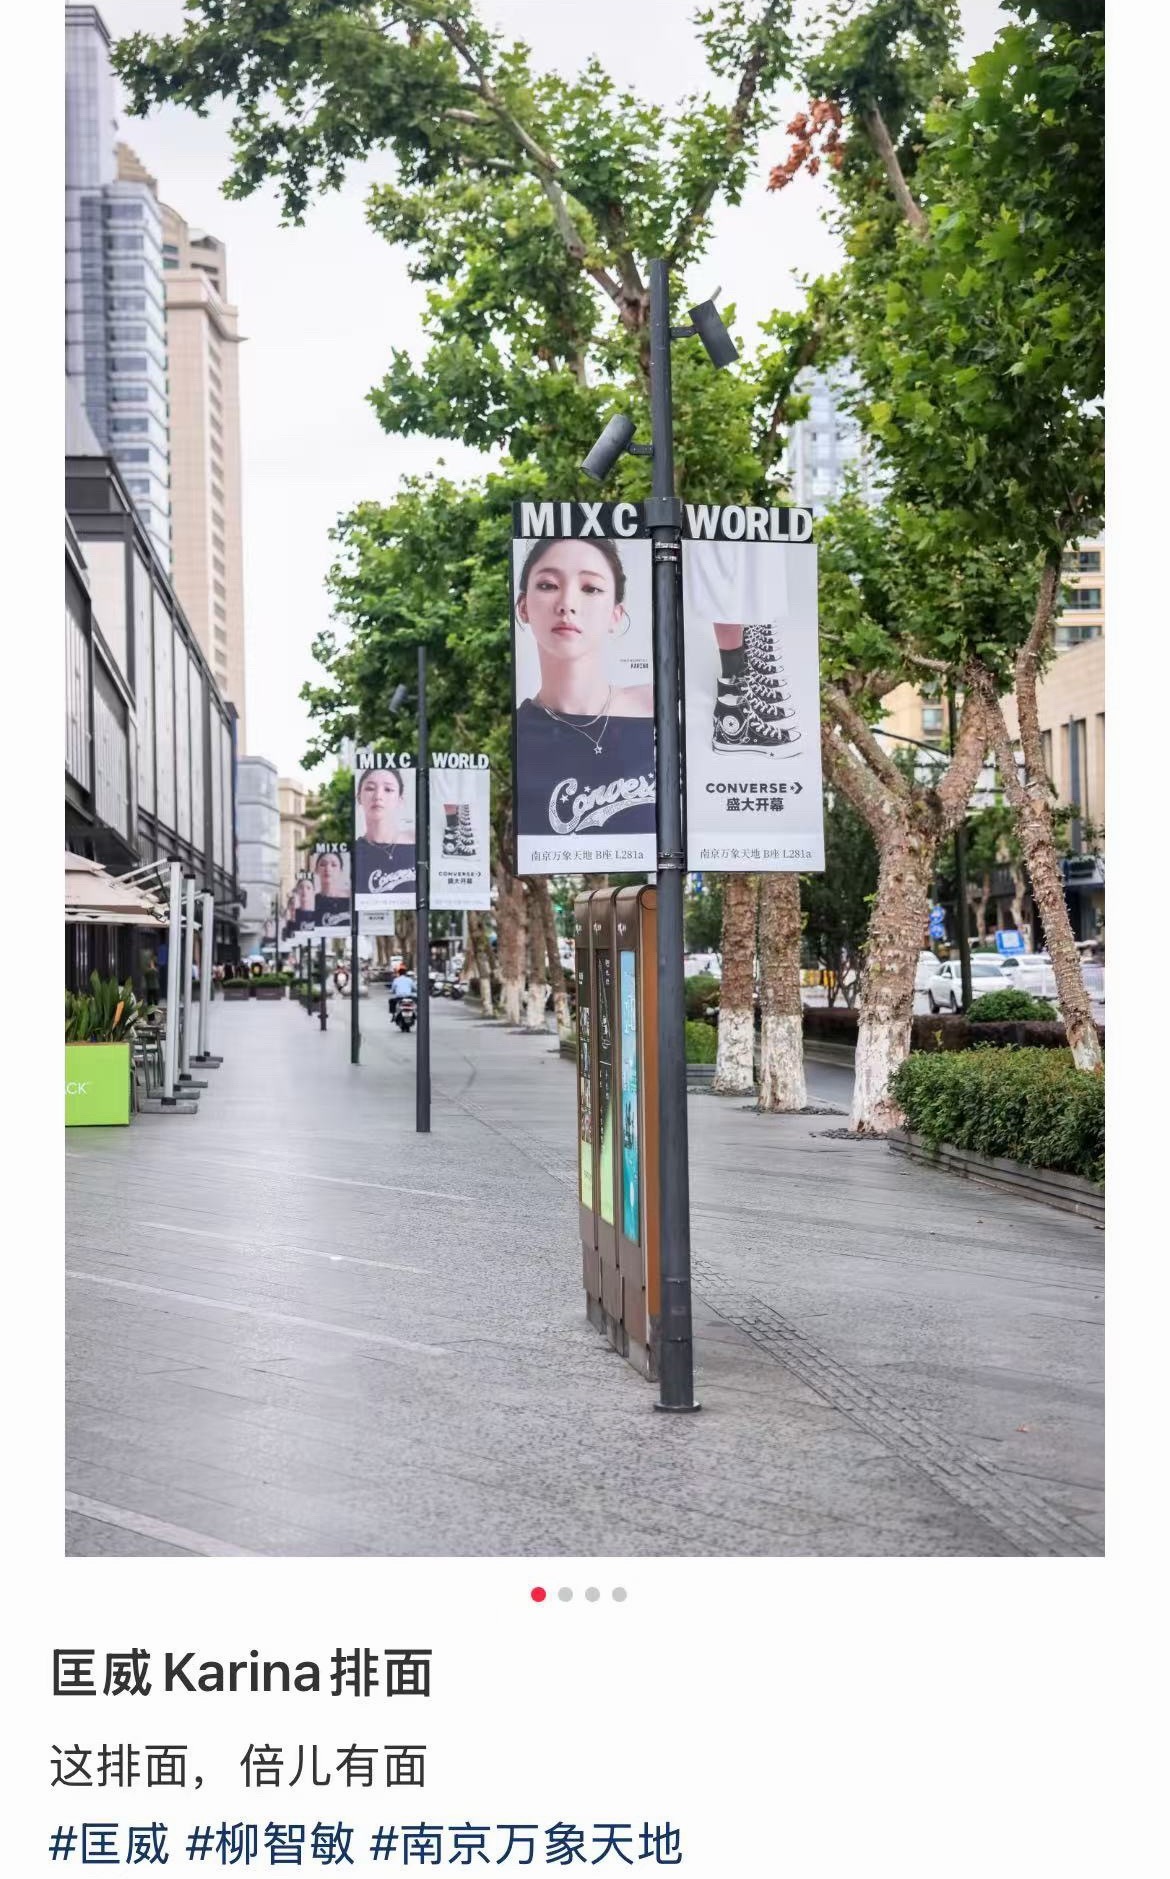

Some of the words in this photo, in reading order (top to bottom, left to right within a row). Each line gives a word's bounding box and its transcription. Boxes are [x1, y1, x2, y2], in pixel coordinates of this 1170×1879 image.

[685, 507, 813, 541] WORLD
[432, 752, 489, 769] WORLD
[705, 782, 787, 794] CONVERSE
[726, 797, 784, 812] 盛大开幕
[531, 850, 593, 862] 南京万象天地
[595, 849, 612, 860] B座
[700, 848, 761, 860] 南京万象天地
[763, 849, 780, 859] B座
[65, 1082, 88, 1095] CK
